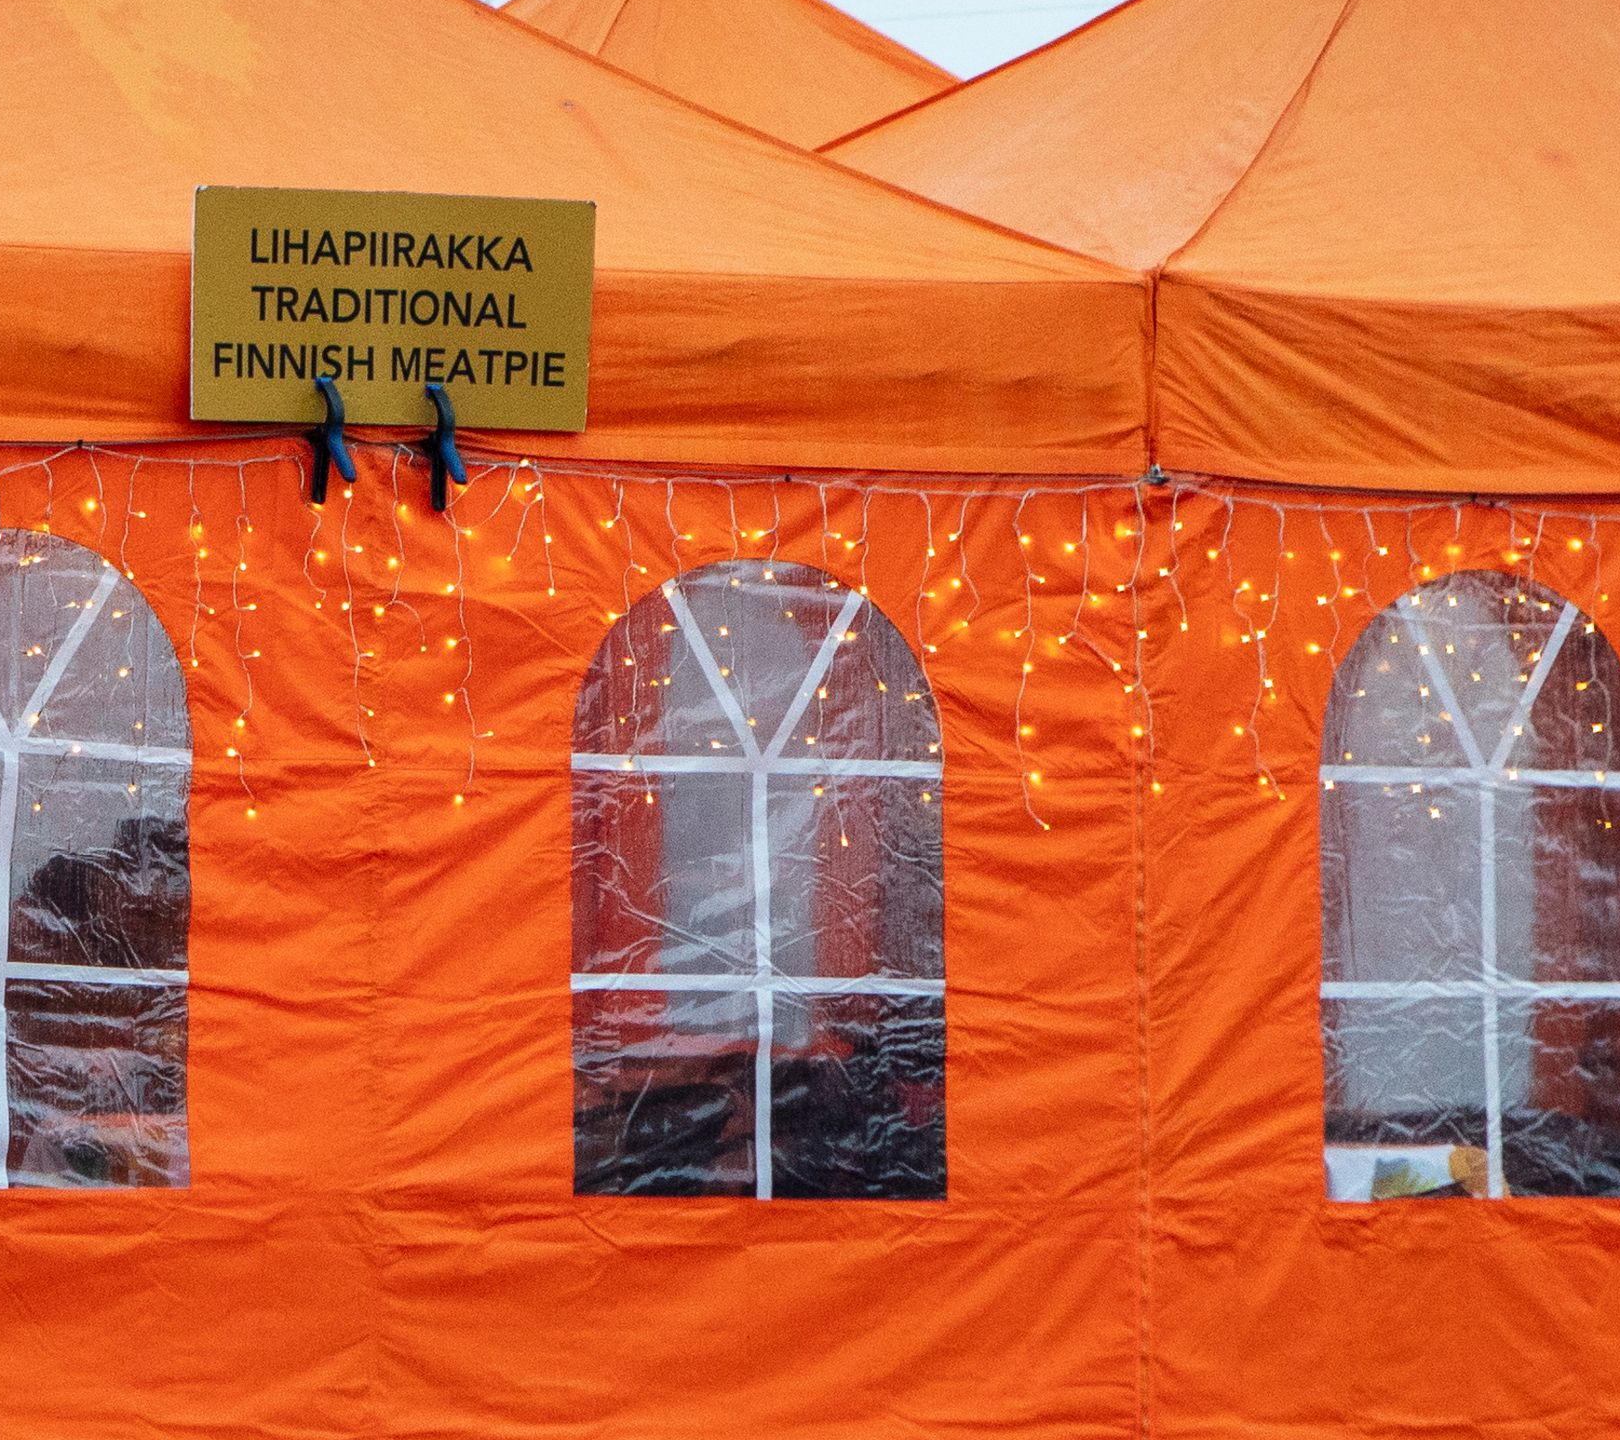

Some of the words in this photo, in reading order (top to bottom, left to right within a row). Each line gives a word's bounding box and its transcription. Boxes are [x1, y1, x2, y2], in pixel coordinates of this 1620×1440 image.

[250, 228, 533, 272] LIHAPIIRAKKA
[251, 286, 527, 329] TRADITIONAL
[213, 343, 375, 381] FINNISH
[391, 346, 566, 387] MEATPIE
